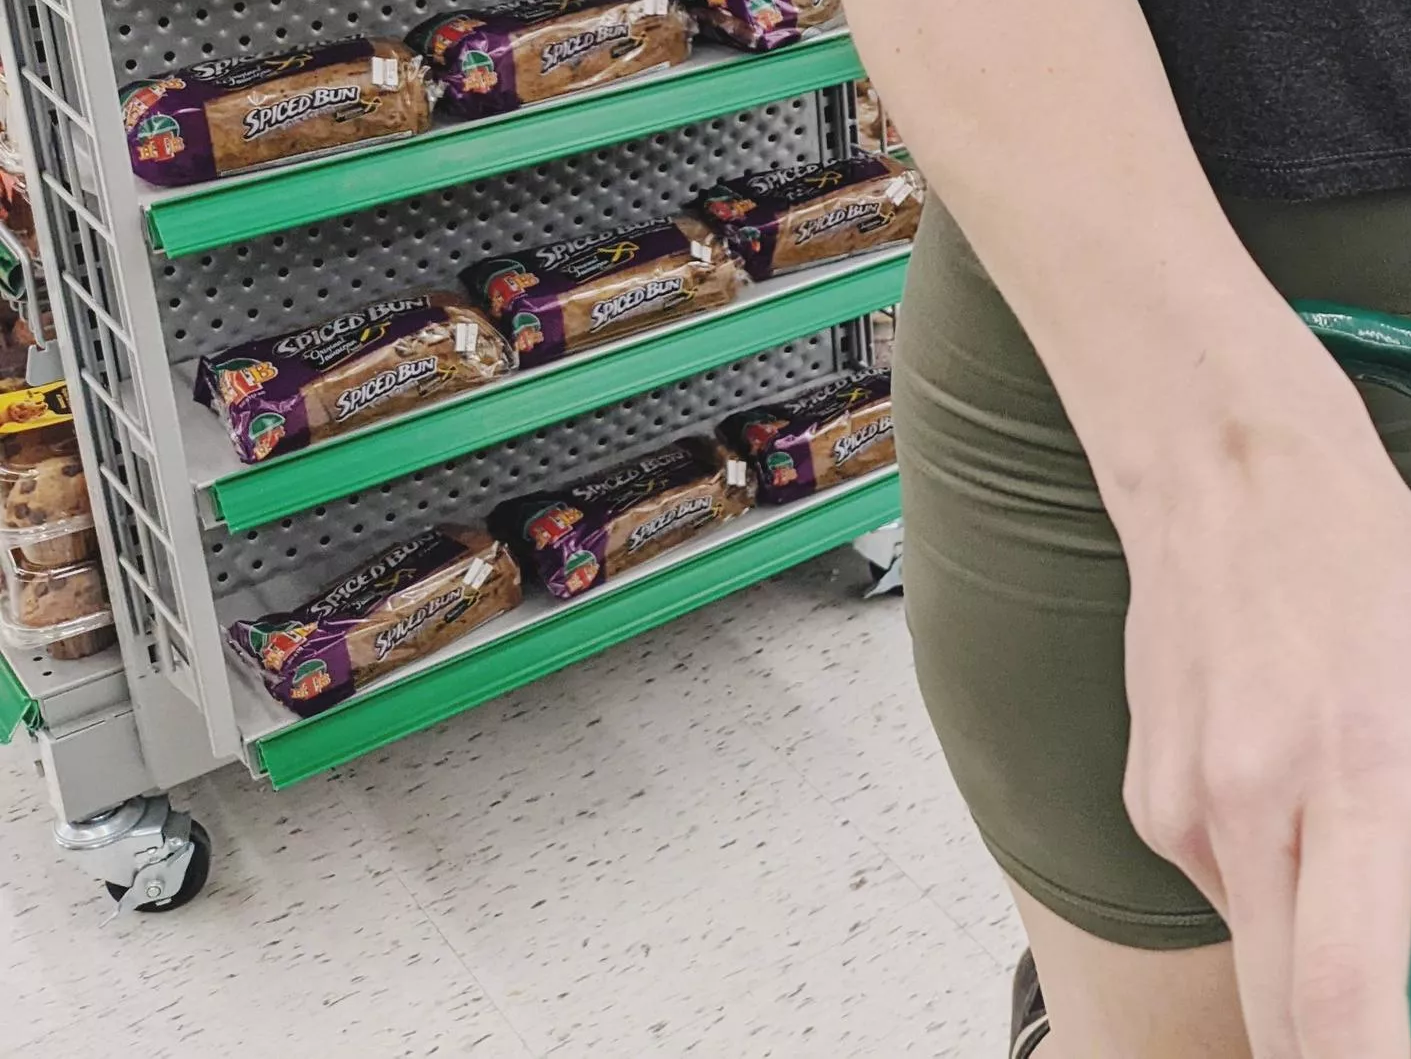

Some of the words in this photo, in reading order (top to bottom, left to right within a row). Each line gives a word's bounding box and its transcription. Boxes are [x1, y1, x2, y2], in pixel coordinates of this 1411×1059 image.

[540, 29, 597, 75] SPICED
[598, 21, 629, 43] BUN
[242, 94, 313, 140] SPICED
[313, 85, 361, 109] BUN
[795, 209, 846, 245] SPICED
[846, 202, 881, 221] BUN
[273, 313, 366, 358] SPICED
[367, 294, 424, 322] BUN
[591, 287, 646, 328] SPICED
[645, 277, 682, 297] BUN
[335, 371, 397, 422] SPICED
[396, 356, 438, 380] BUN
[832, 422, 880, 466] SPICED
[628, 508, 678, 554] SPICED
[677, 496, 713, 519] BUN
[310, 562, 388, 618] SPICED
[374, 609, 425, 662] SPICED
[424, 586, 466, 615] BUN
